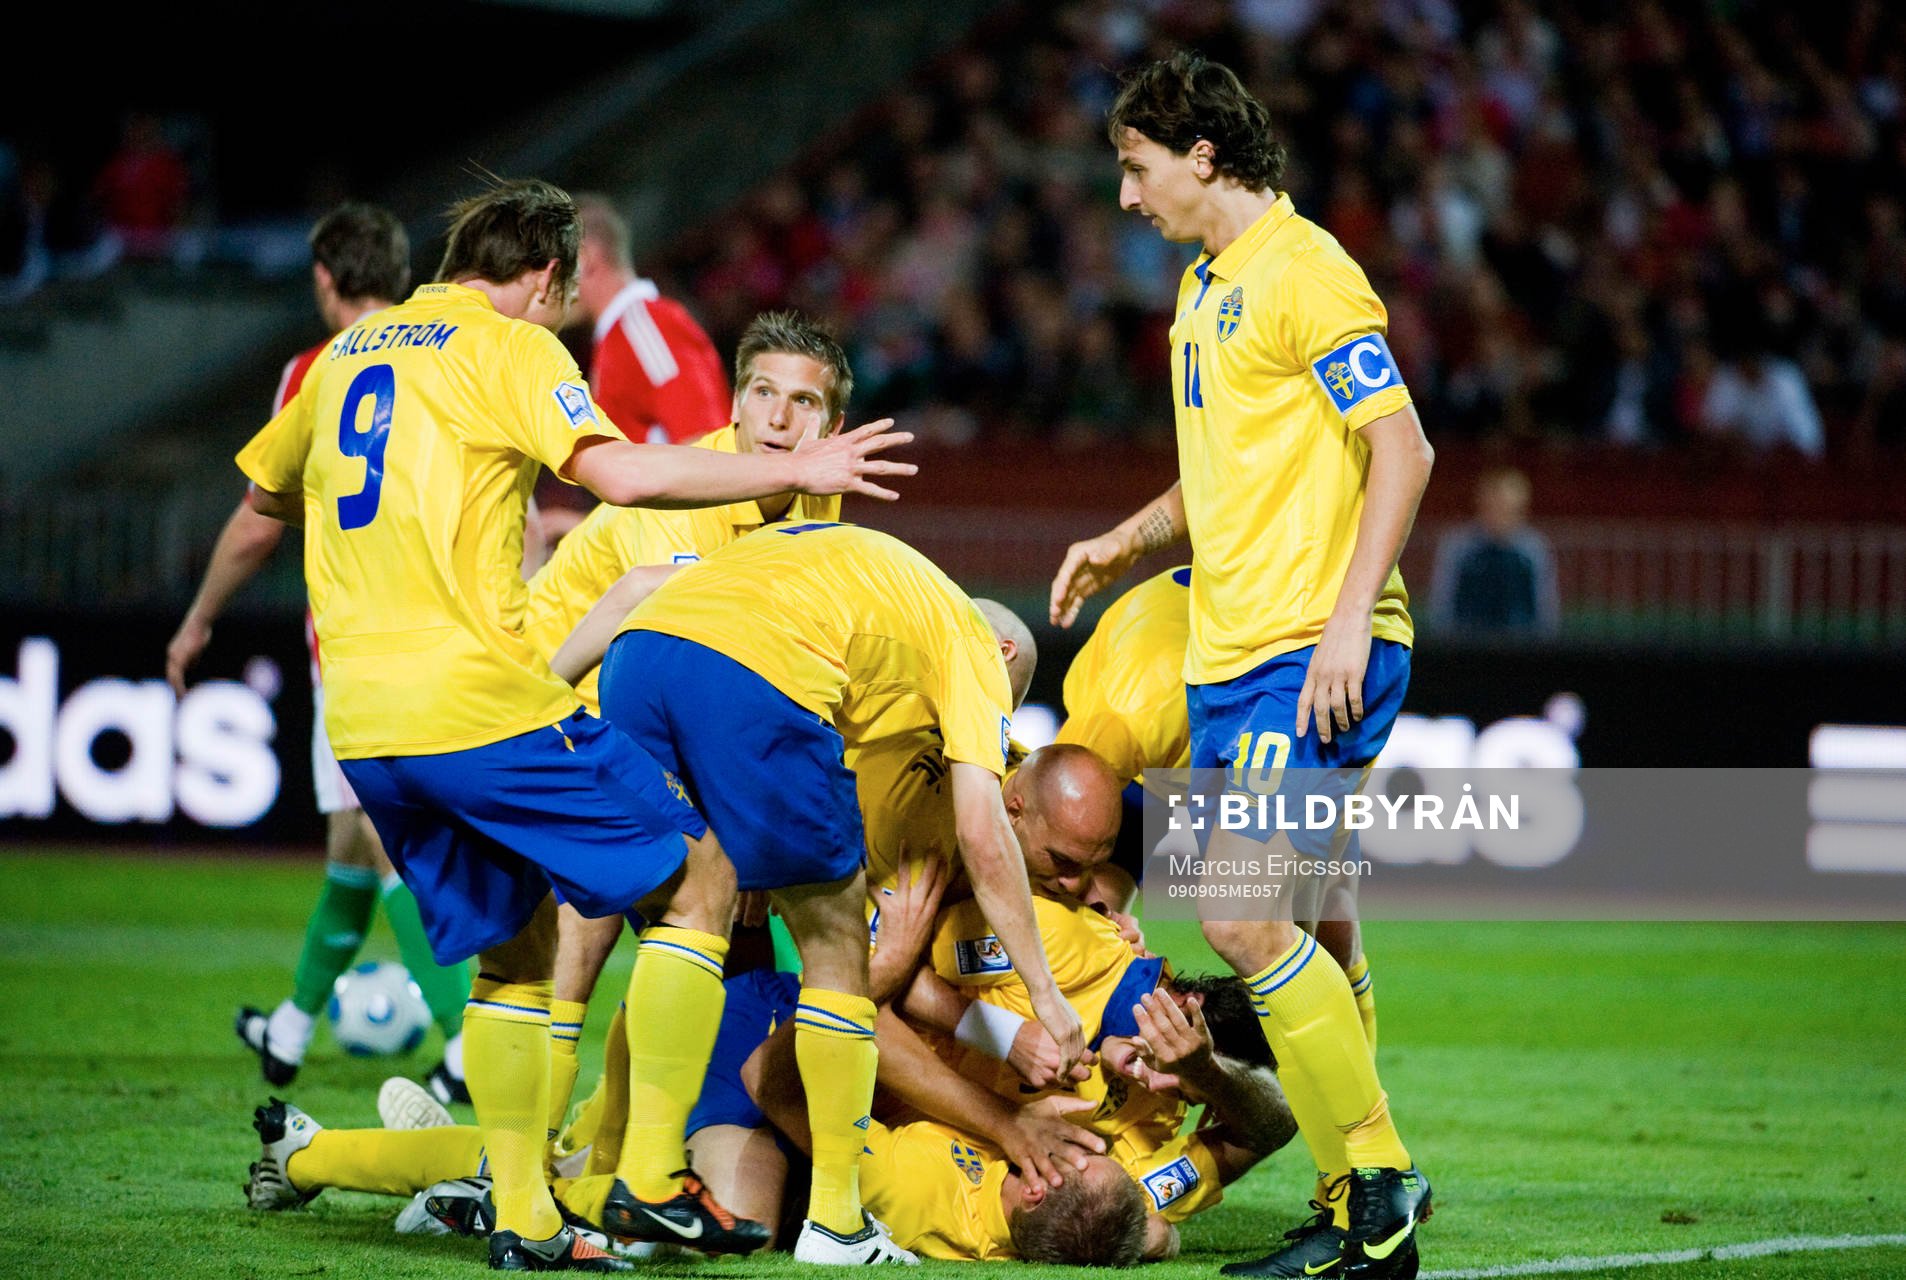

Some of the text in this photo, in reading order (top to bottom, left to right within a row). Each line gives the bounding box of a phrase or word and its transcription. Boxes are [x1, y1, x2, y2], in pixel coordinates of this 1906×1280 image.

[1349, 341, 1391, 388] C
[337, 364, 395, 531] 9
[1232, 731, 1291, 796] 10
